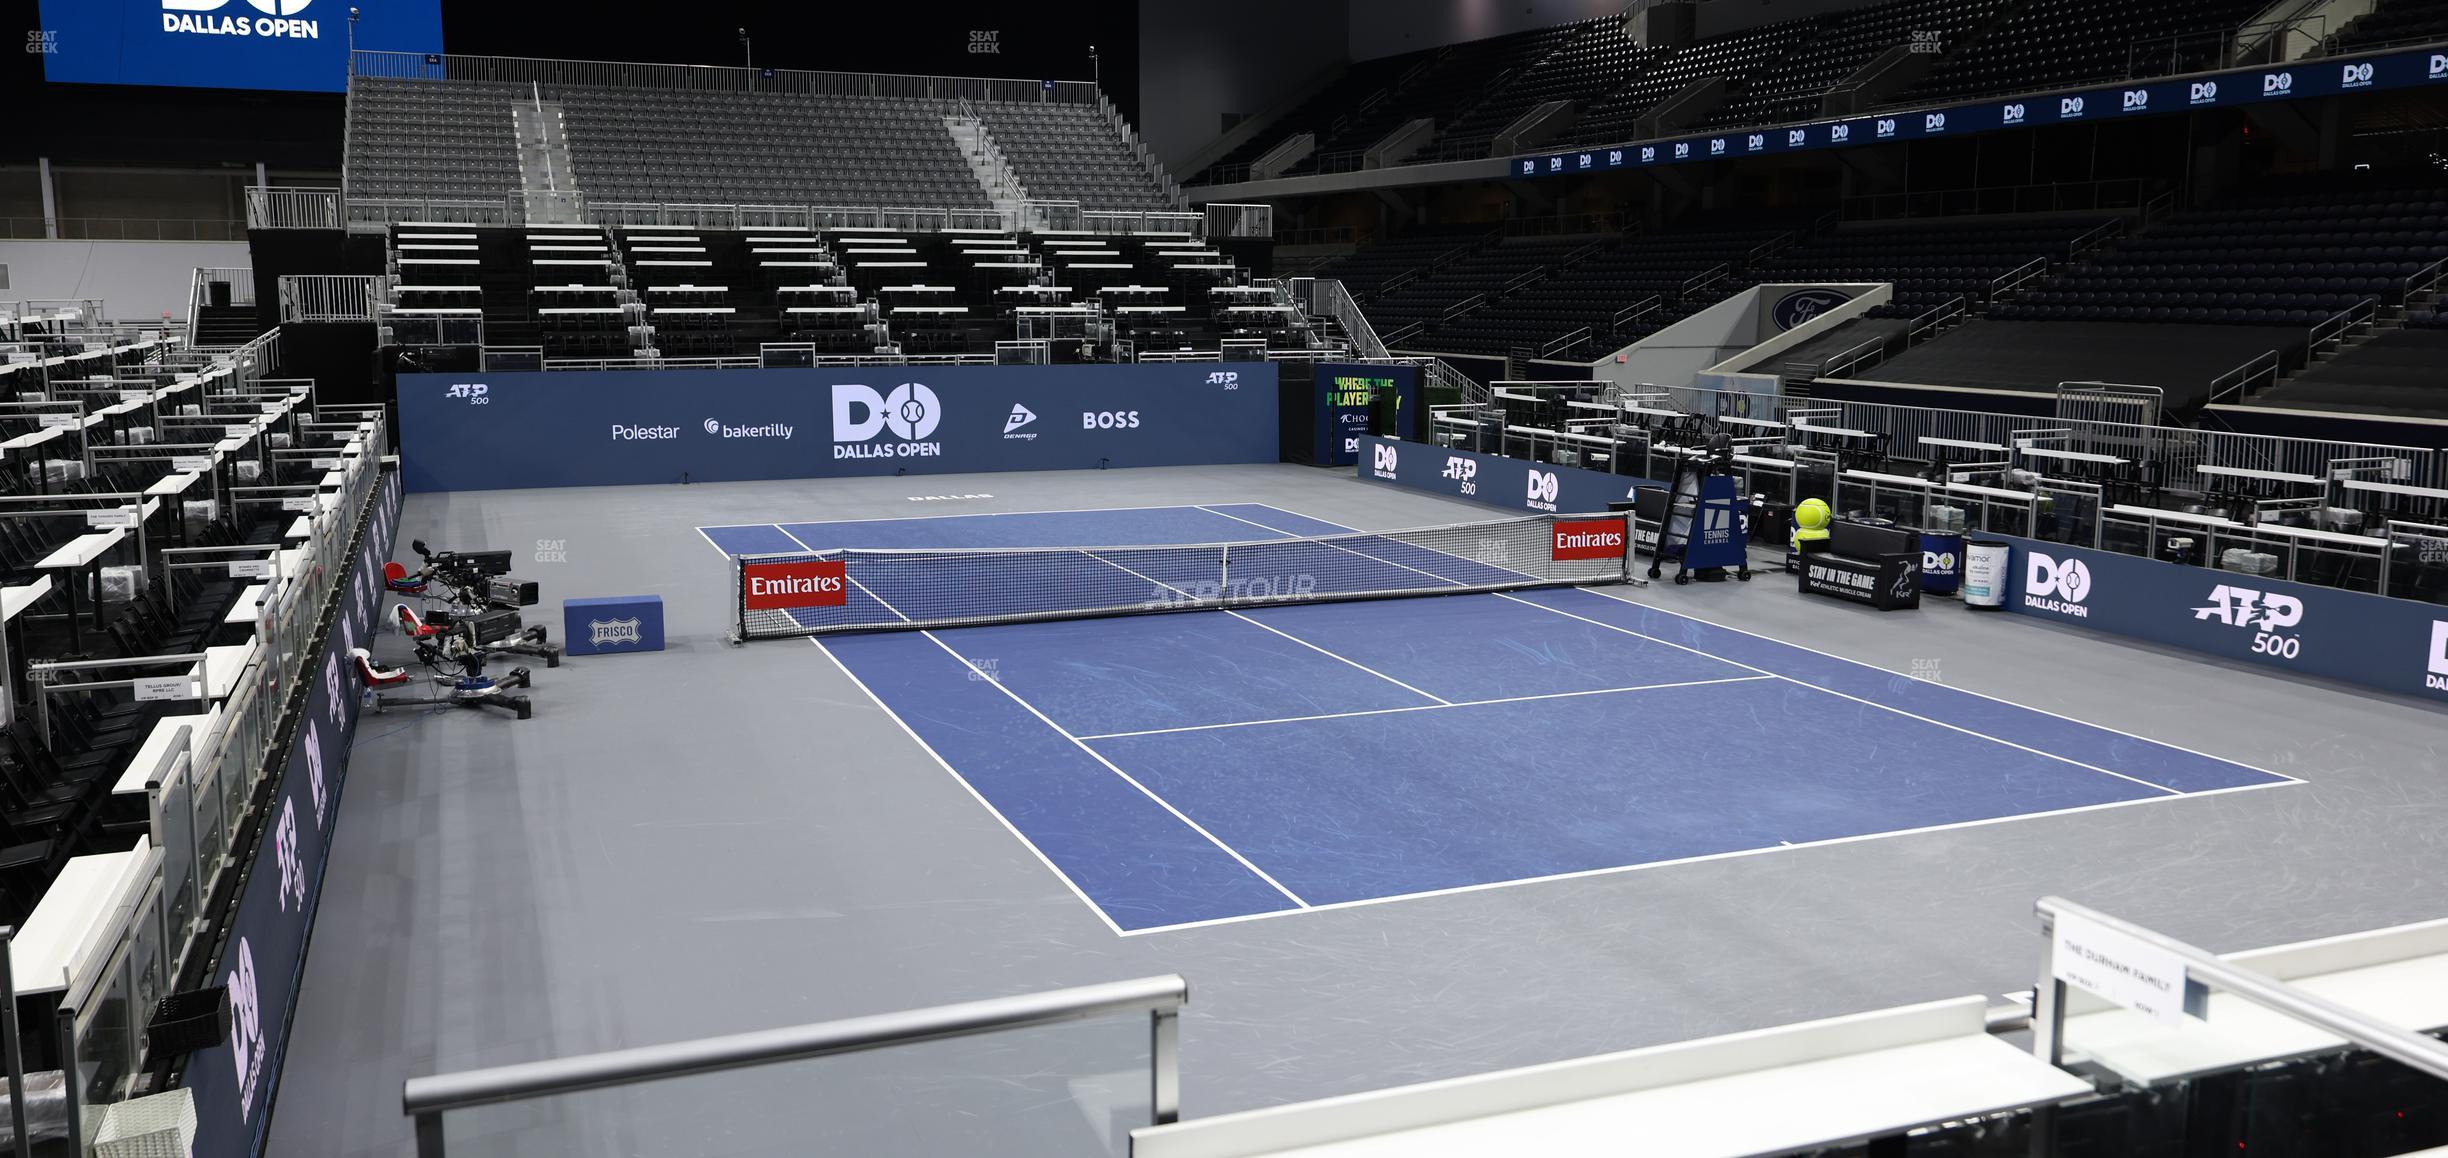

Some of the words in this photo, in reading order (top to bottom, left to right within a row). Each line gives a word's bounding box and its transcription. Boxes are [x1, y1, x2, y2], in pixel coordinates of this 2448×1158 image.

[163, 13, 251, 35] DALLAS
[255, 19, 318, 39] OPEN
[1206, 372, 1238, 385] ATP
[444, 383, 488, 398] ATP
[471, 397, 489, 405] 500
[1327, 392, 1368, 407] PLAYER
[1083, 411, 1140, 430] BOSS
[612, 424, 680, 440] Polestar
[723, 423, 793, 440] bakertilly
[833, 443, 894, 460] DALLAS
[897, 441, 941, 457] OPEN
[1441, 456, 1476, 481] ATP
[1461, 481, 1476, 496] 500
[907, 494, 994, 502] DALLAS
[1527, 499, 1543, 510] DALLAS
[1544, 502, 1557, 512] OPEN
[1557, 532, 1621, 549] Emirates
[1704, 529, 1730, 540] TENNIS
[751, 573, 841, 597] Emirates
[1808, 564, 1825, 581] STAY
[1826, 567, 1836, 582] IN
[1836, 570, 1852, 586] THE
[1851, 572, 1875, 590] GAME
[2025, 595, 2060, 613] DALLAS
[2060, 602, 2088, 618] OPEN
[2191, 584, 2303, 633] ATP
[597, 626, 633, 637] FRISCO
[2251, 631, 2300, 660] 500
